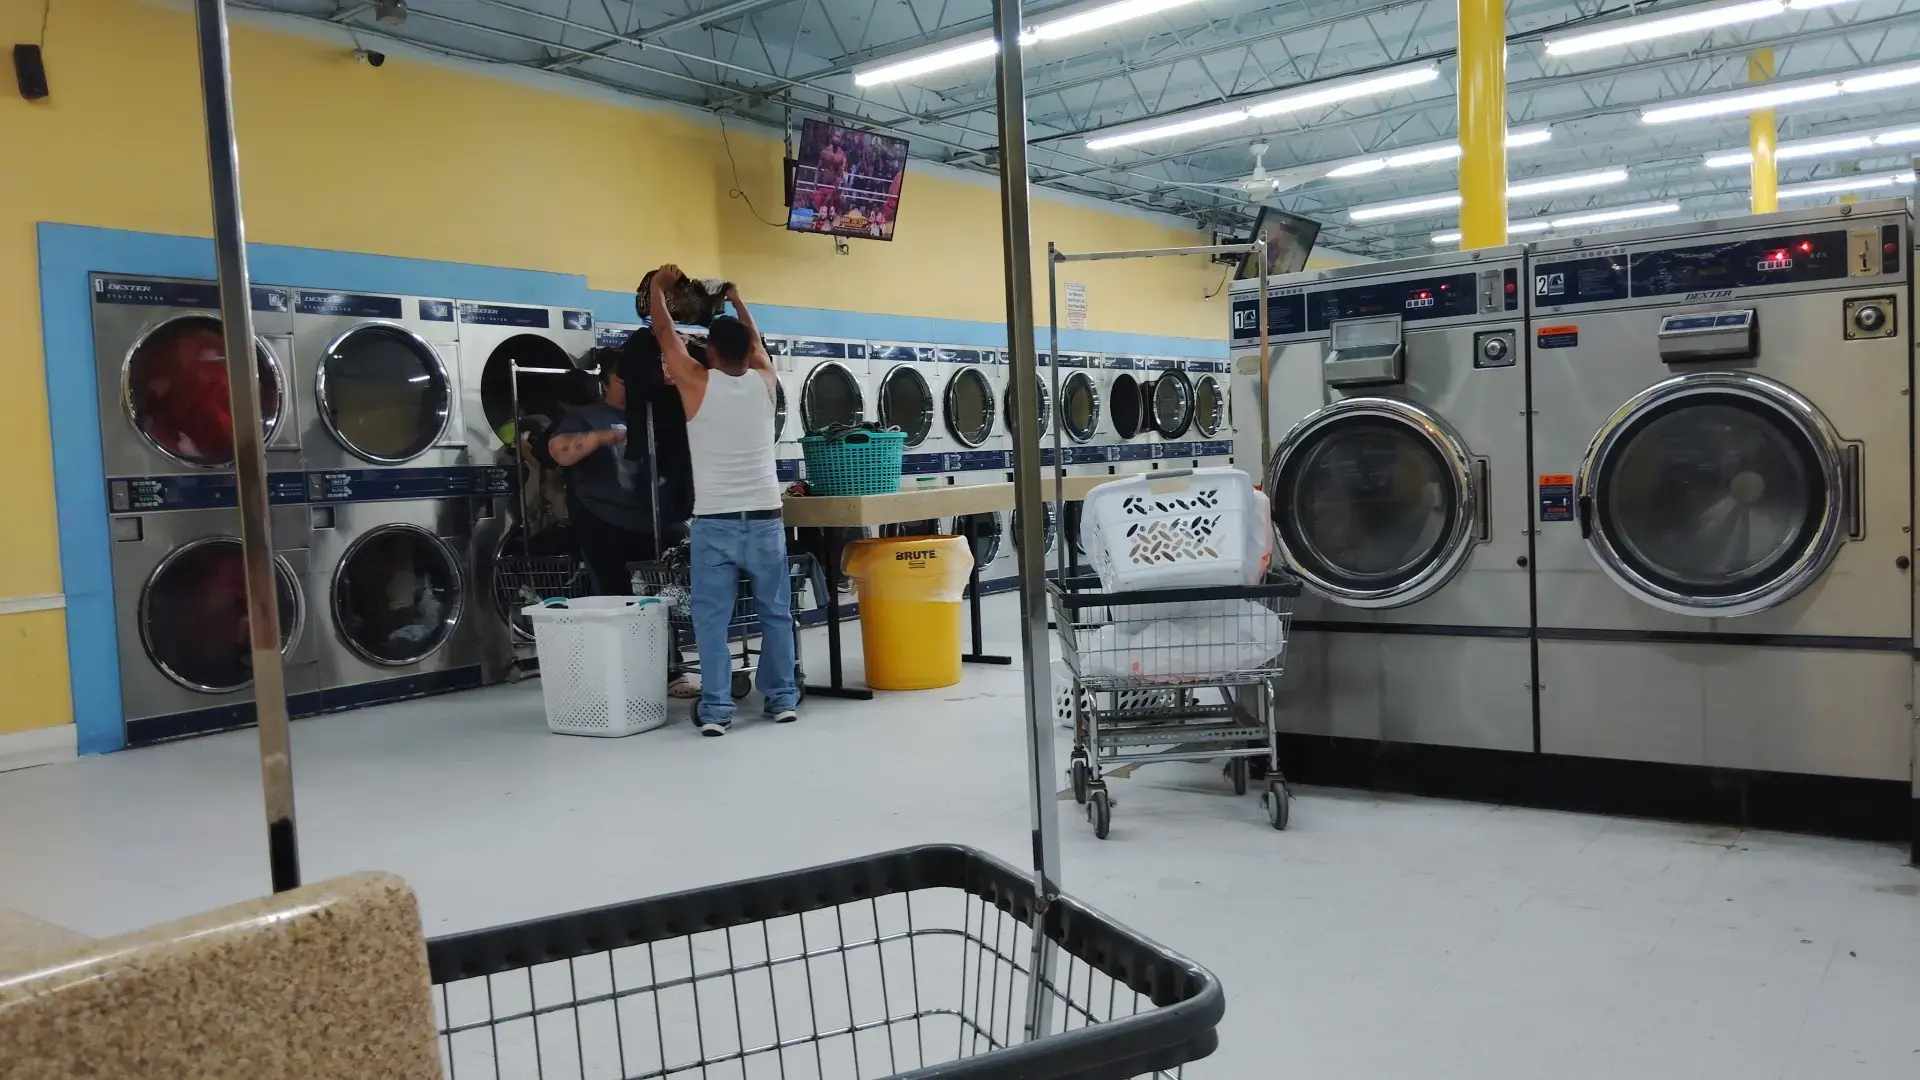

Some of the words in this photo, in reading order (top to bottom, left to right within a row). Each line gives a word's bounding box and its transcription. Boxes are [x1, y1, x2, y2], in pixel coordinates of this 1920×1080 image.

[97, 279, 103, 292] 1
[107, 283, 152, 292] DEXTER
[1537, 276, 1547, 295] 2
[295, 292, 301, 303] 2
[1685, 290, 1732, 301] DEXTER
[1236, 312, 1243, 329] 1
[896, 550, 936, 561] BRUTE
